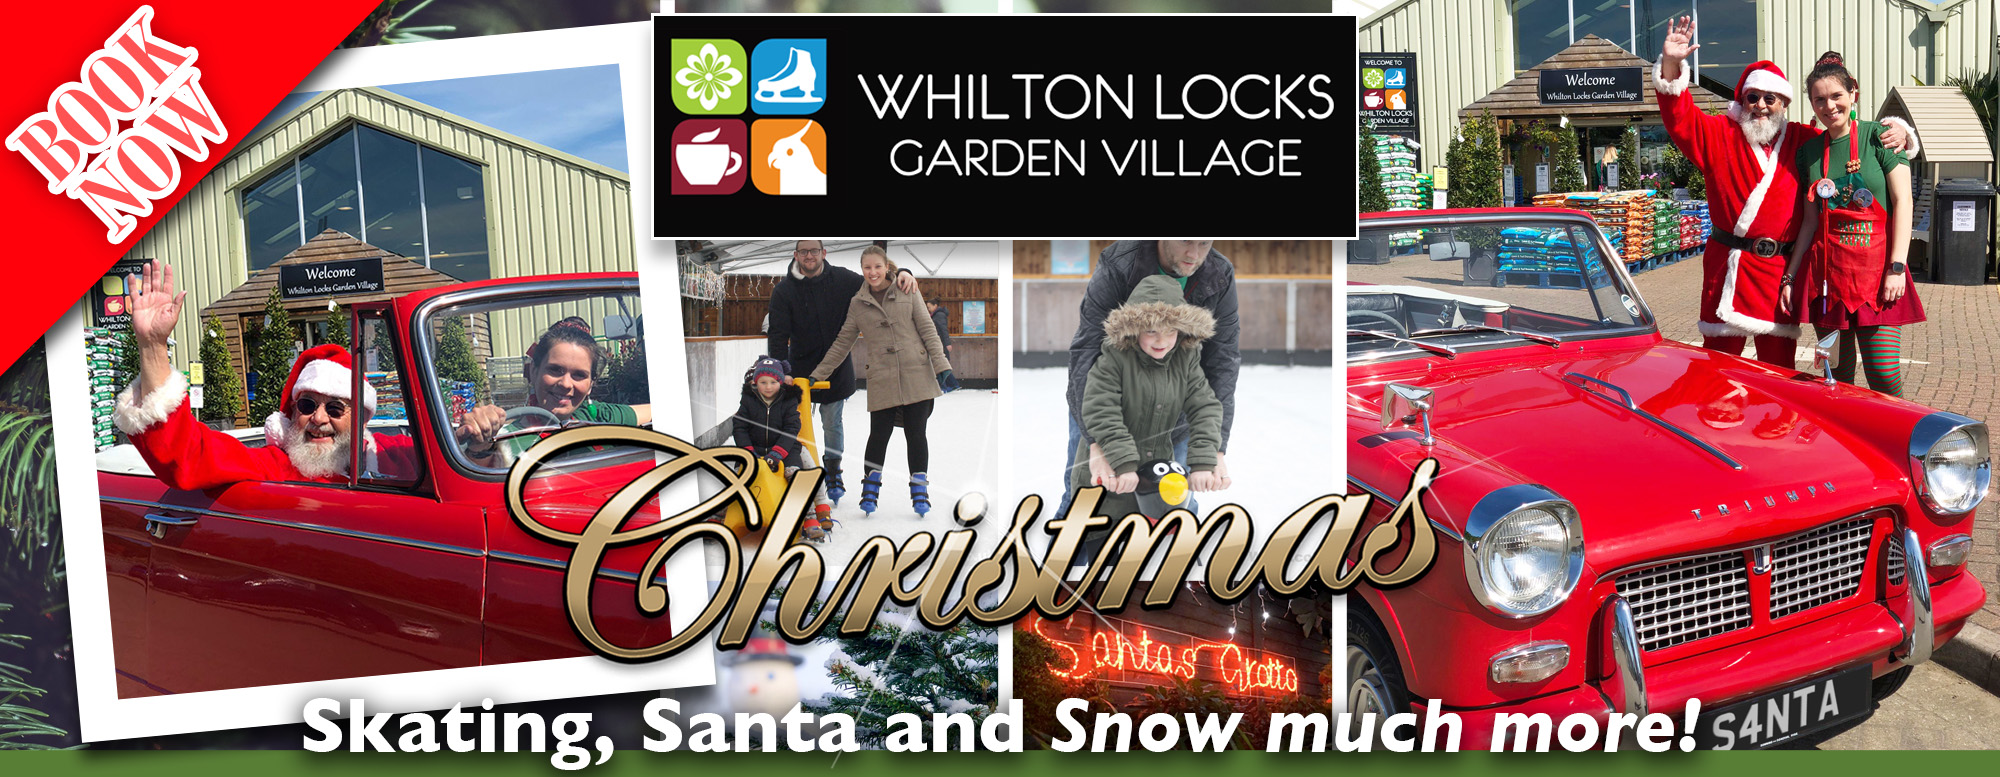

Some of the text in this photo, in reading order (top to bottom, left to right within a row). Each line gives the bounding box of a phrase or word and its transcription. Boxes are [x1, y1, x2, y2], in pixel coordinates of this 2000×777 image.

[1565, 71, 1616, 86] Welcome
[1546, 90, 1638, 101] Whilton Locks Garden Village
[305, 265, 356, 280] Welcome
[287, 280, 378, 295] Whilton Locks Garden Village
[1690, 481, 1836, 521] TRIUMPH
[1219, 642, 1298, 692] Grotto
[1712, 679, 1839, 750] S4NTA
